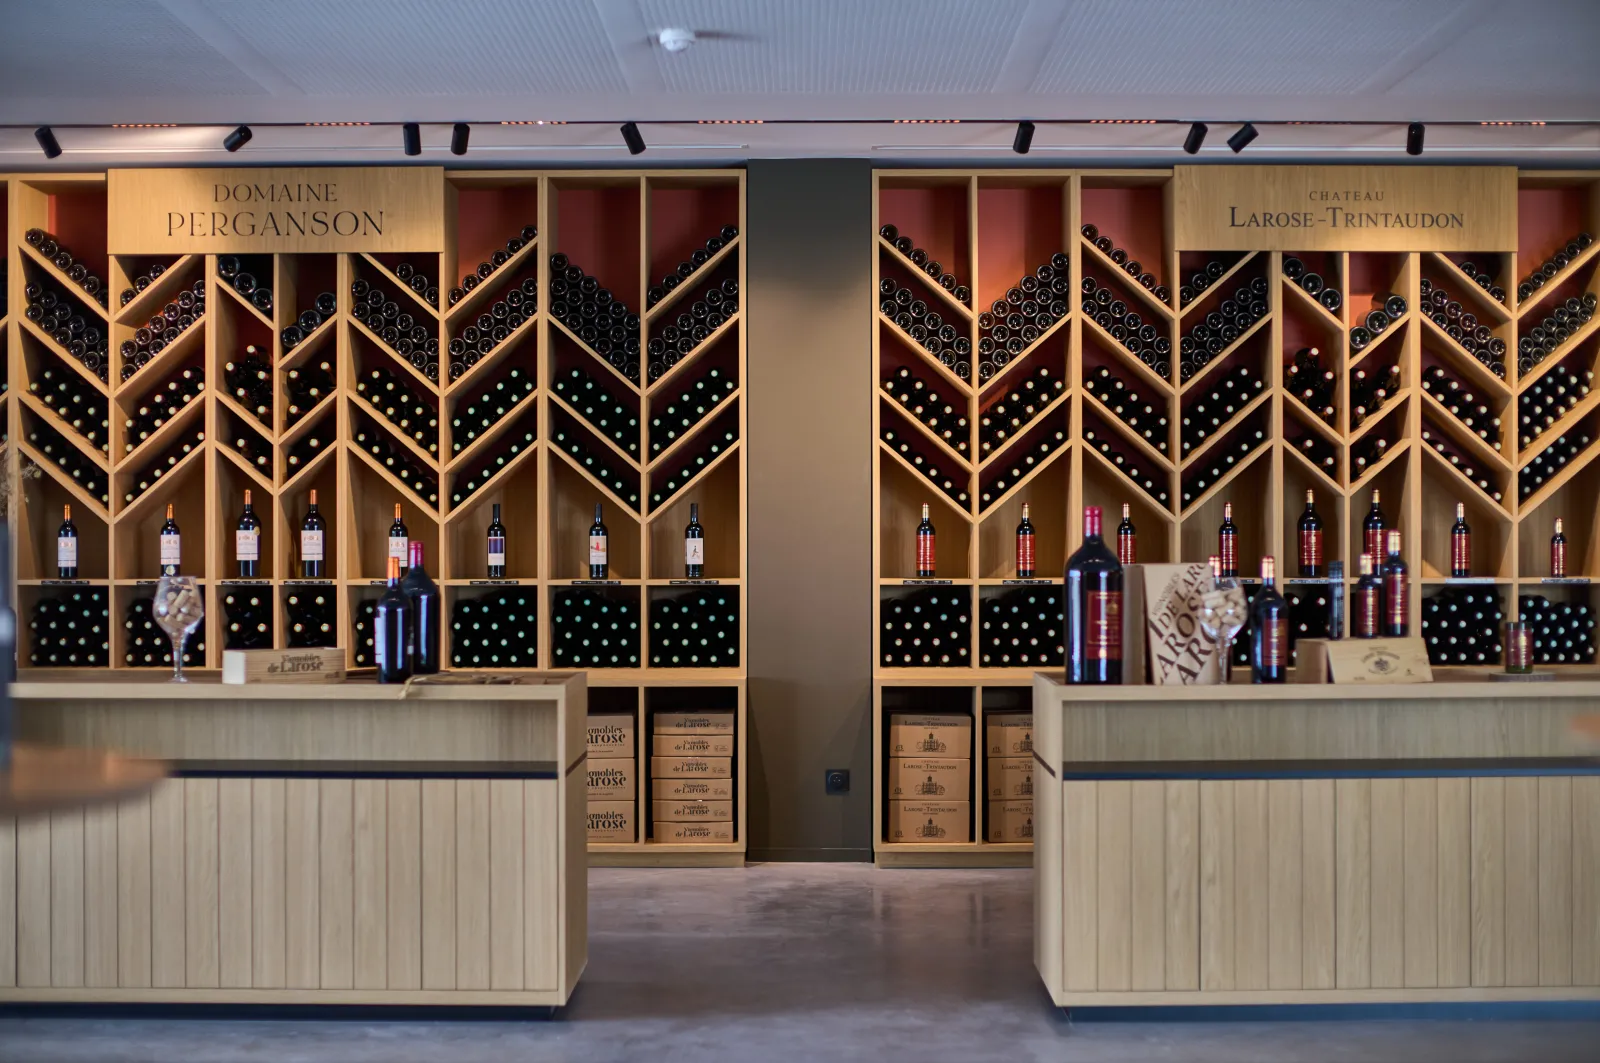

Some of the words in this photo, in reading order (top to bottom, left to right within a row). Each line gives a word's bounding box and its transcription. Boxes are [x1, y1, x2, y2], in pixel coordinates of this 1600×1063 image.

[214, 183, 338, 203] DOMAINE
[1308, 190, 1385, 202] CHATEAU
[167, 210, 384, 237] PERGANSON
[281, 661, 324, 673] Larose
